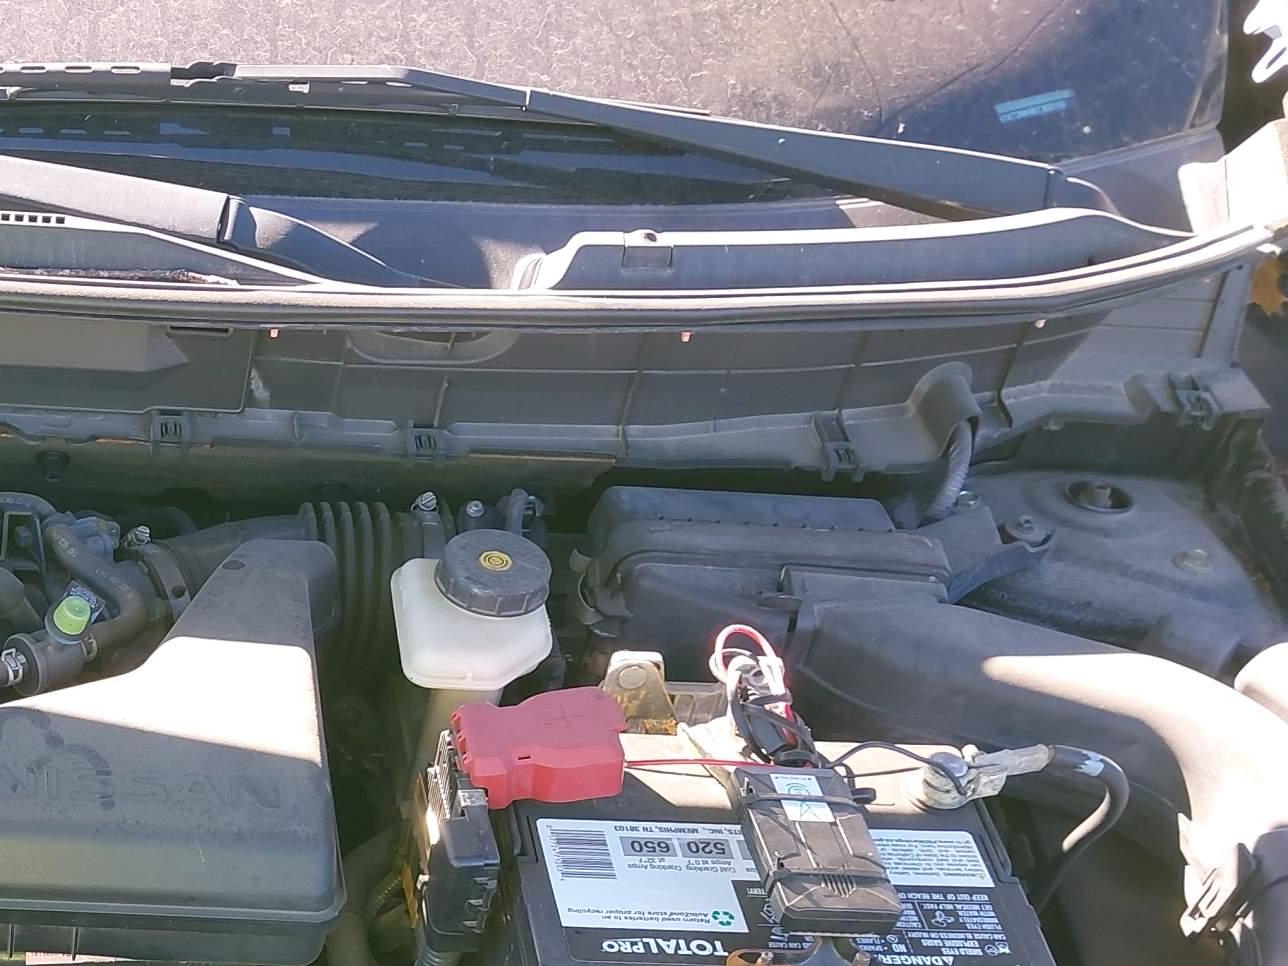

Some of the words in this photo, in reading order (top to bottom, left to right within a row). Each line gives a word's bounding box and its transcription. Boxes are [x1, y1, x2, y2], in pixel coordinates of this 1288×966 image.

[614, 824, 640, 832] 38103
[642, 825, 653, 833] TN
[655, 825, 699, 835] MEMPHIS,
[630, 840, 671, 854] 650
[687, 840, 726, 855] 520
[649, 863, 682, 872] Cranking
[685, 864, 719, 874] Cranking
[567, 907, 604, 915] recycling
[605, 907, 632, 916] proper
[624, 915, 659, 923] batteries
[601, 937, 729, 957] TOTALPRO
[891, 943, 908, 953] NO
